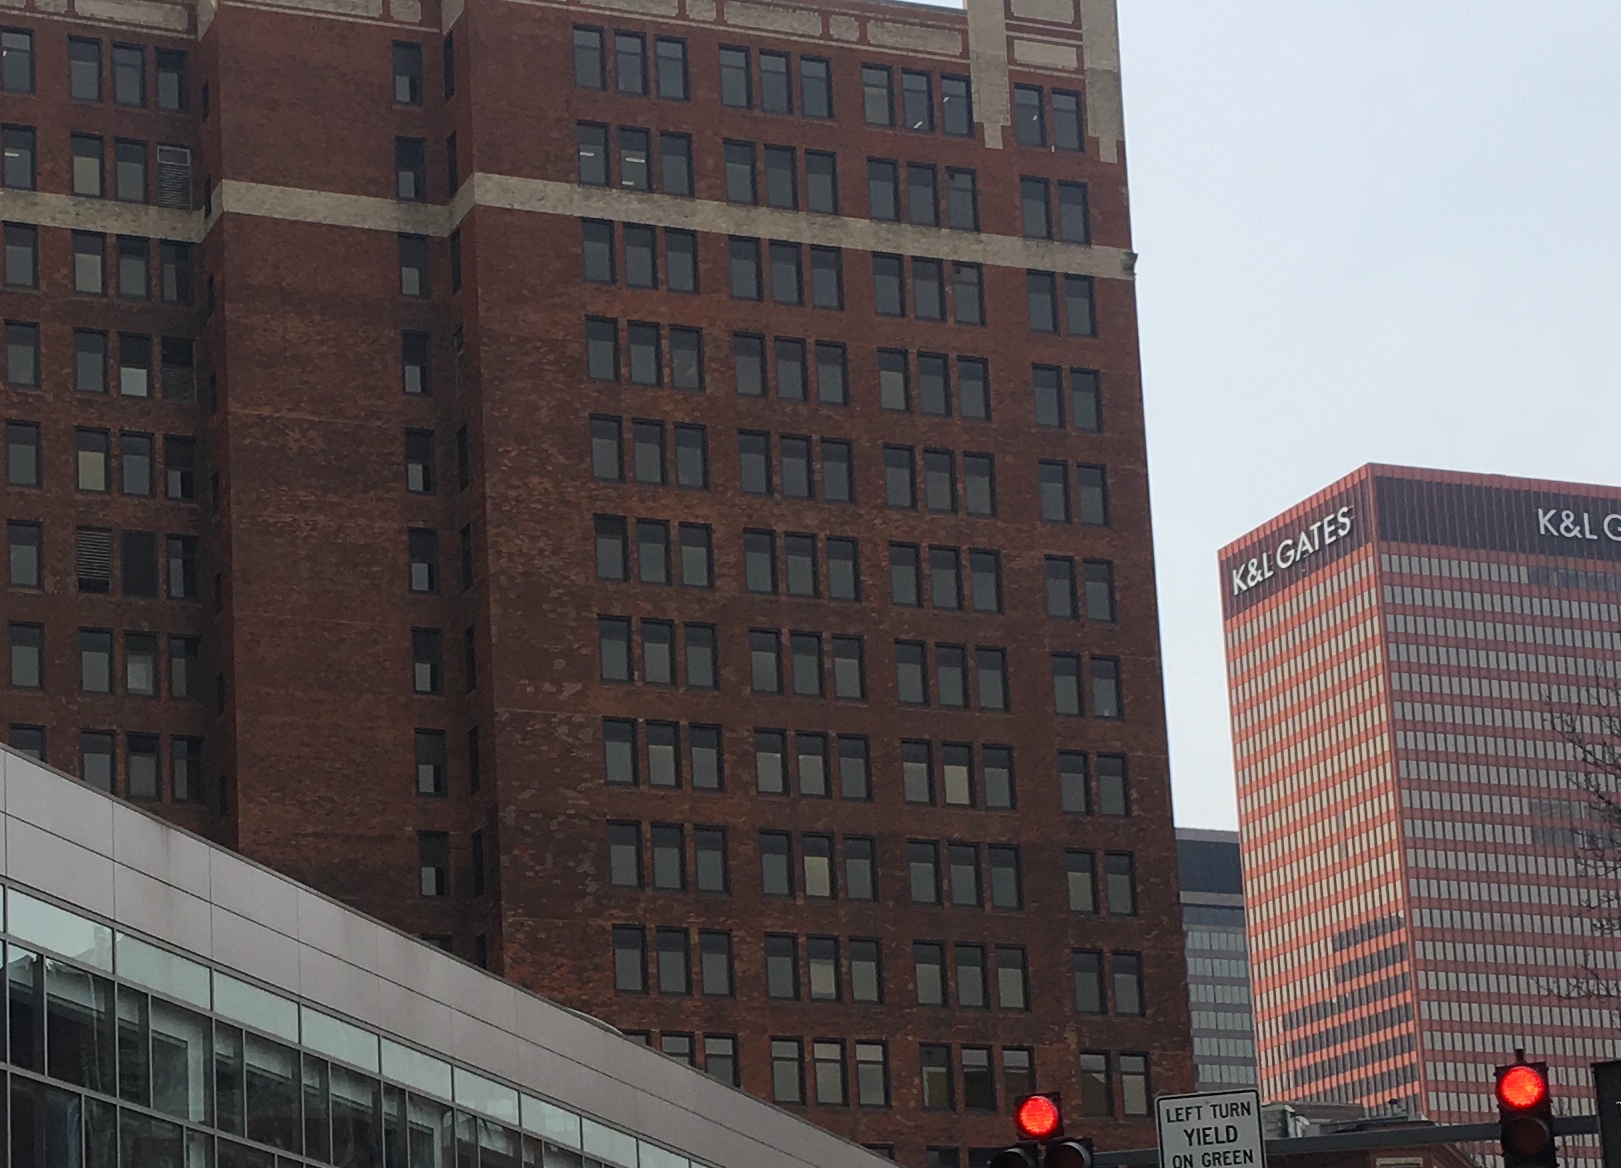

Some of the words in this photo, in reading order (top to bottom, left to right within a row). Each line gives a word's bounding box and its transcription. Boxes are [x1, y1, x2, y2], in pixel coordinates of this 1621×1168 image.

[1537, 508, 1598, 540] K&L
[1232, 552, 1274, 596] K&L
[1276, 506, 1351, 569] GATES
[1166, 1106, 1203, 1123] LEFT
[1210, 1101, 1251, 1119] TURN
[1183, 1125, 1238, 1147] YIELD
[1201, 1149, 1254, 1168] GREEN
